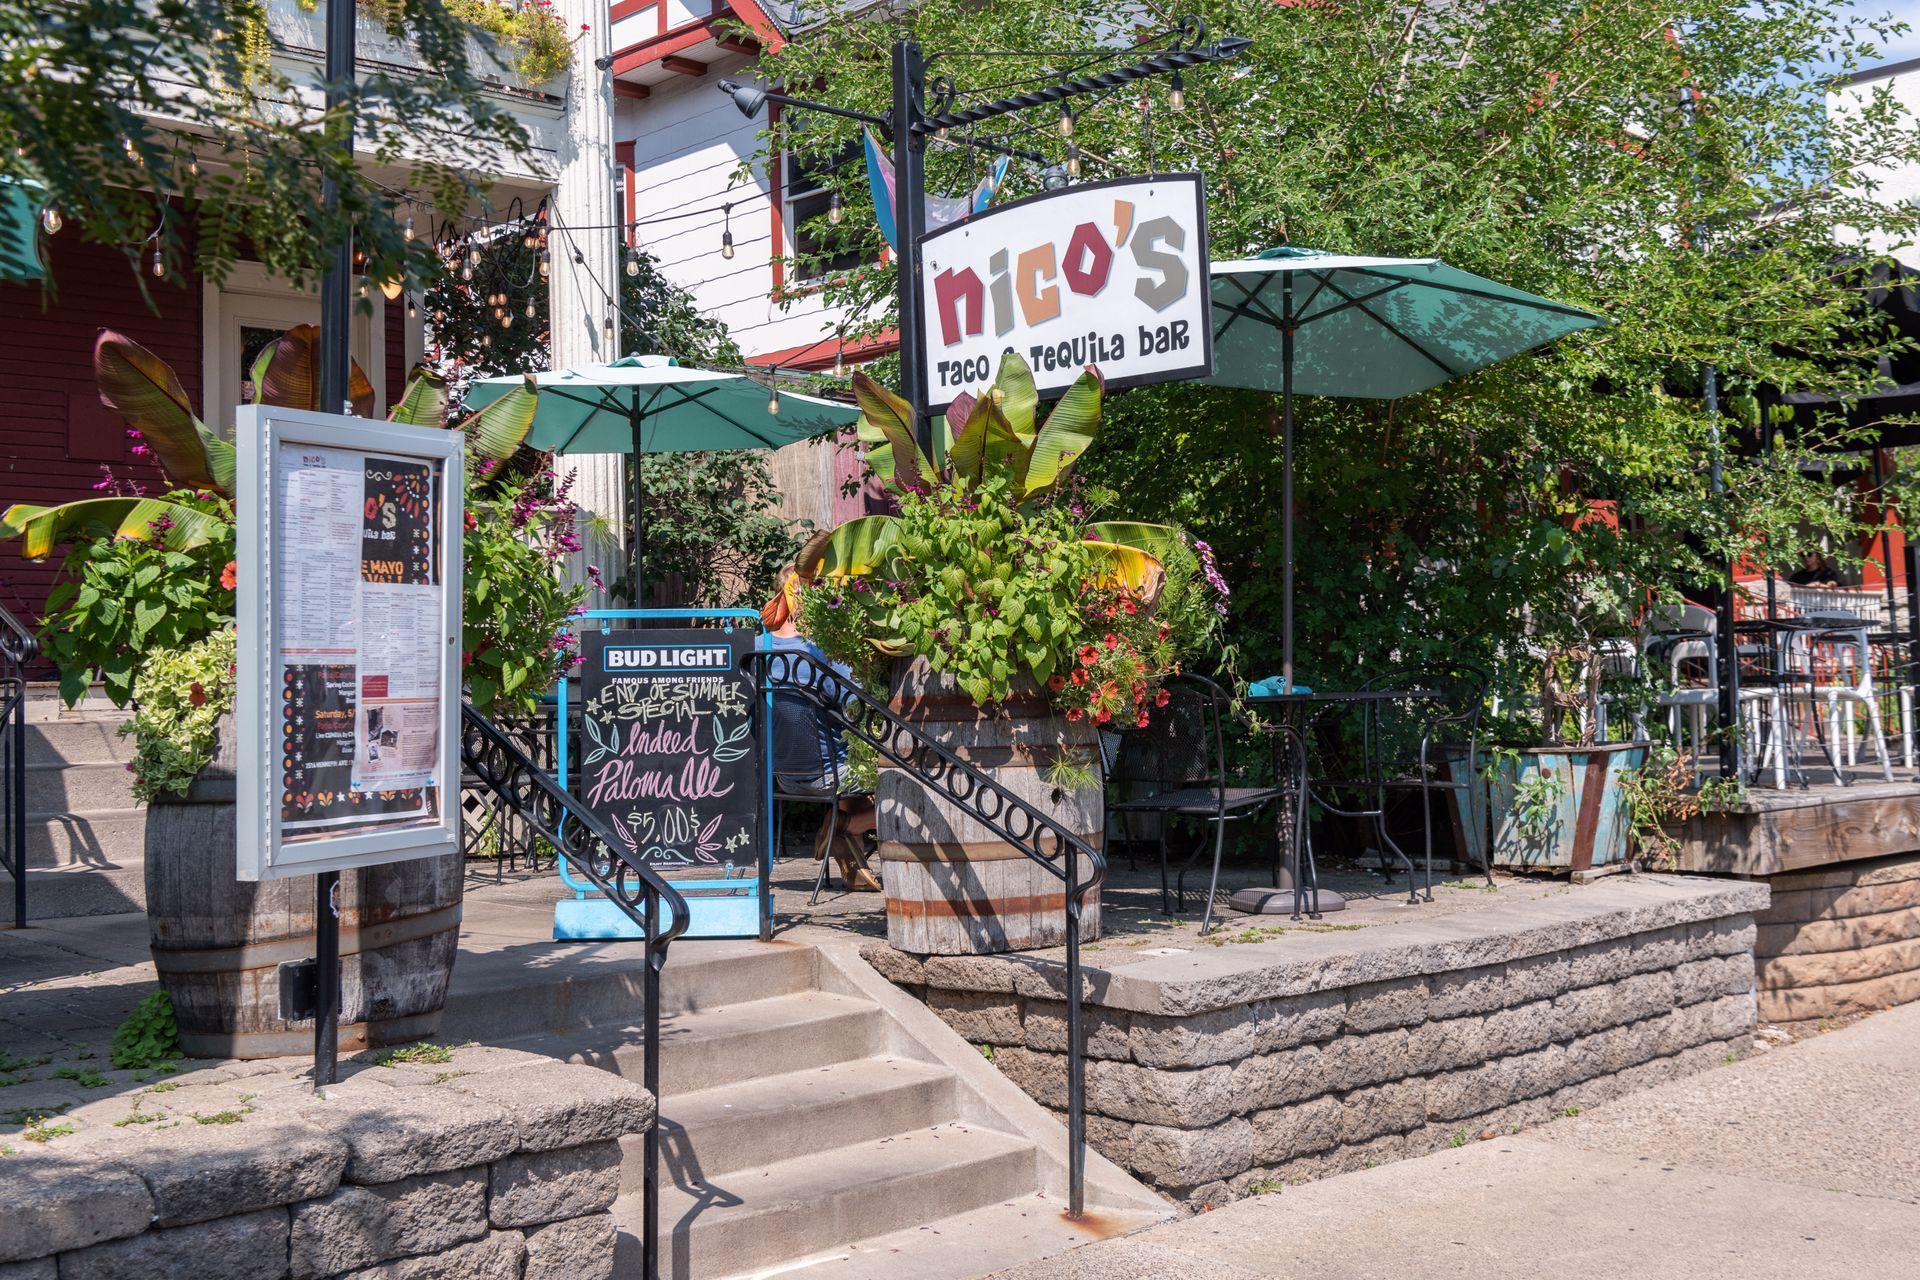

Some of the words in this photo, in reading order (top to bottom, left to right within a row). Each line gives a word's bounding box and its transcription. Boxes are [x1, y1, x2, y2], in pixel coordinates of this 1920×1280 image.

[370, 560, 404, 575] MAYO
[608, 650, 657, 667] BUD
[660, 649, 727, 667] LIGHT
[612, 677, 649, 685] FAMOUS
[686, 676, 724, 684] FRIENDS
[601, 683, 639, 704] END
[650, 684, 670, 700] OF
[670, 681, 748, 701] SUMMER
[617, 698, 713, 725] SPECIAL
[620, 716, 709, 757] Indeed
[587, 759, 681, 809] Paloma
[680, 756, 735, 800] Ale
